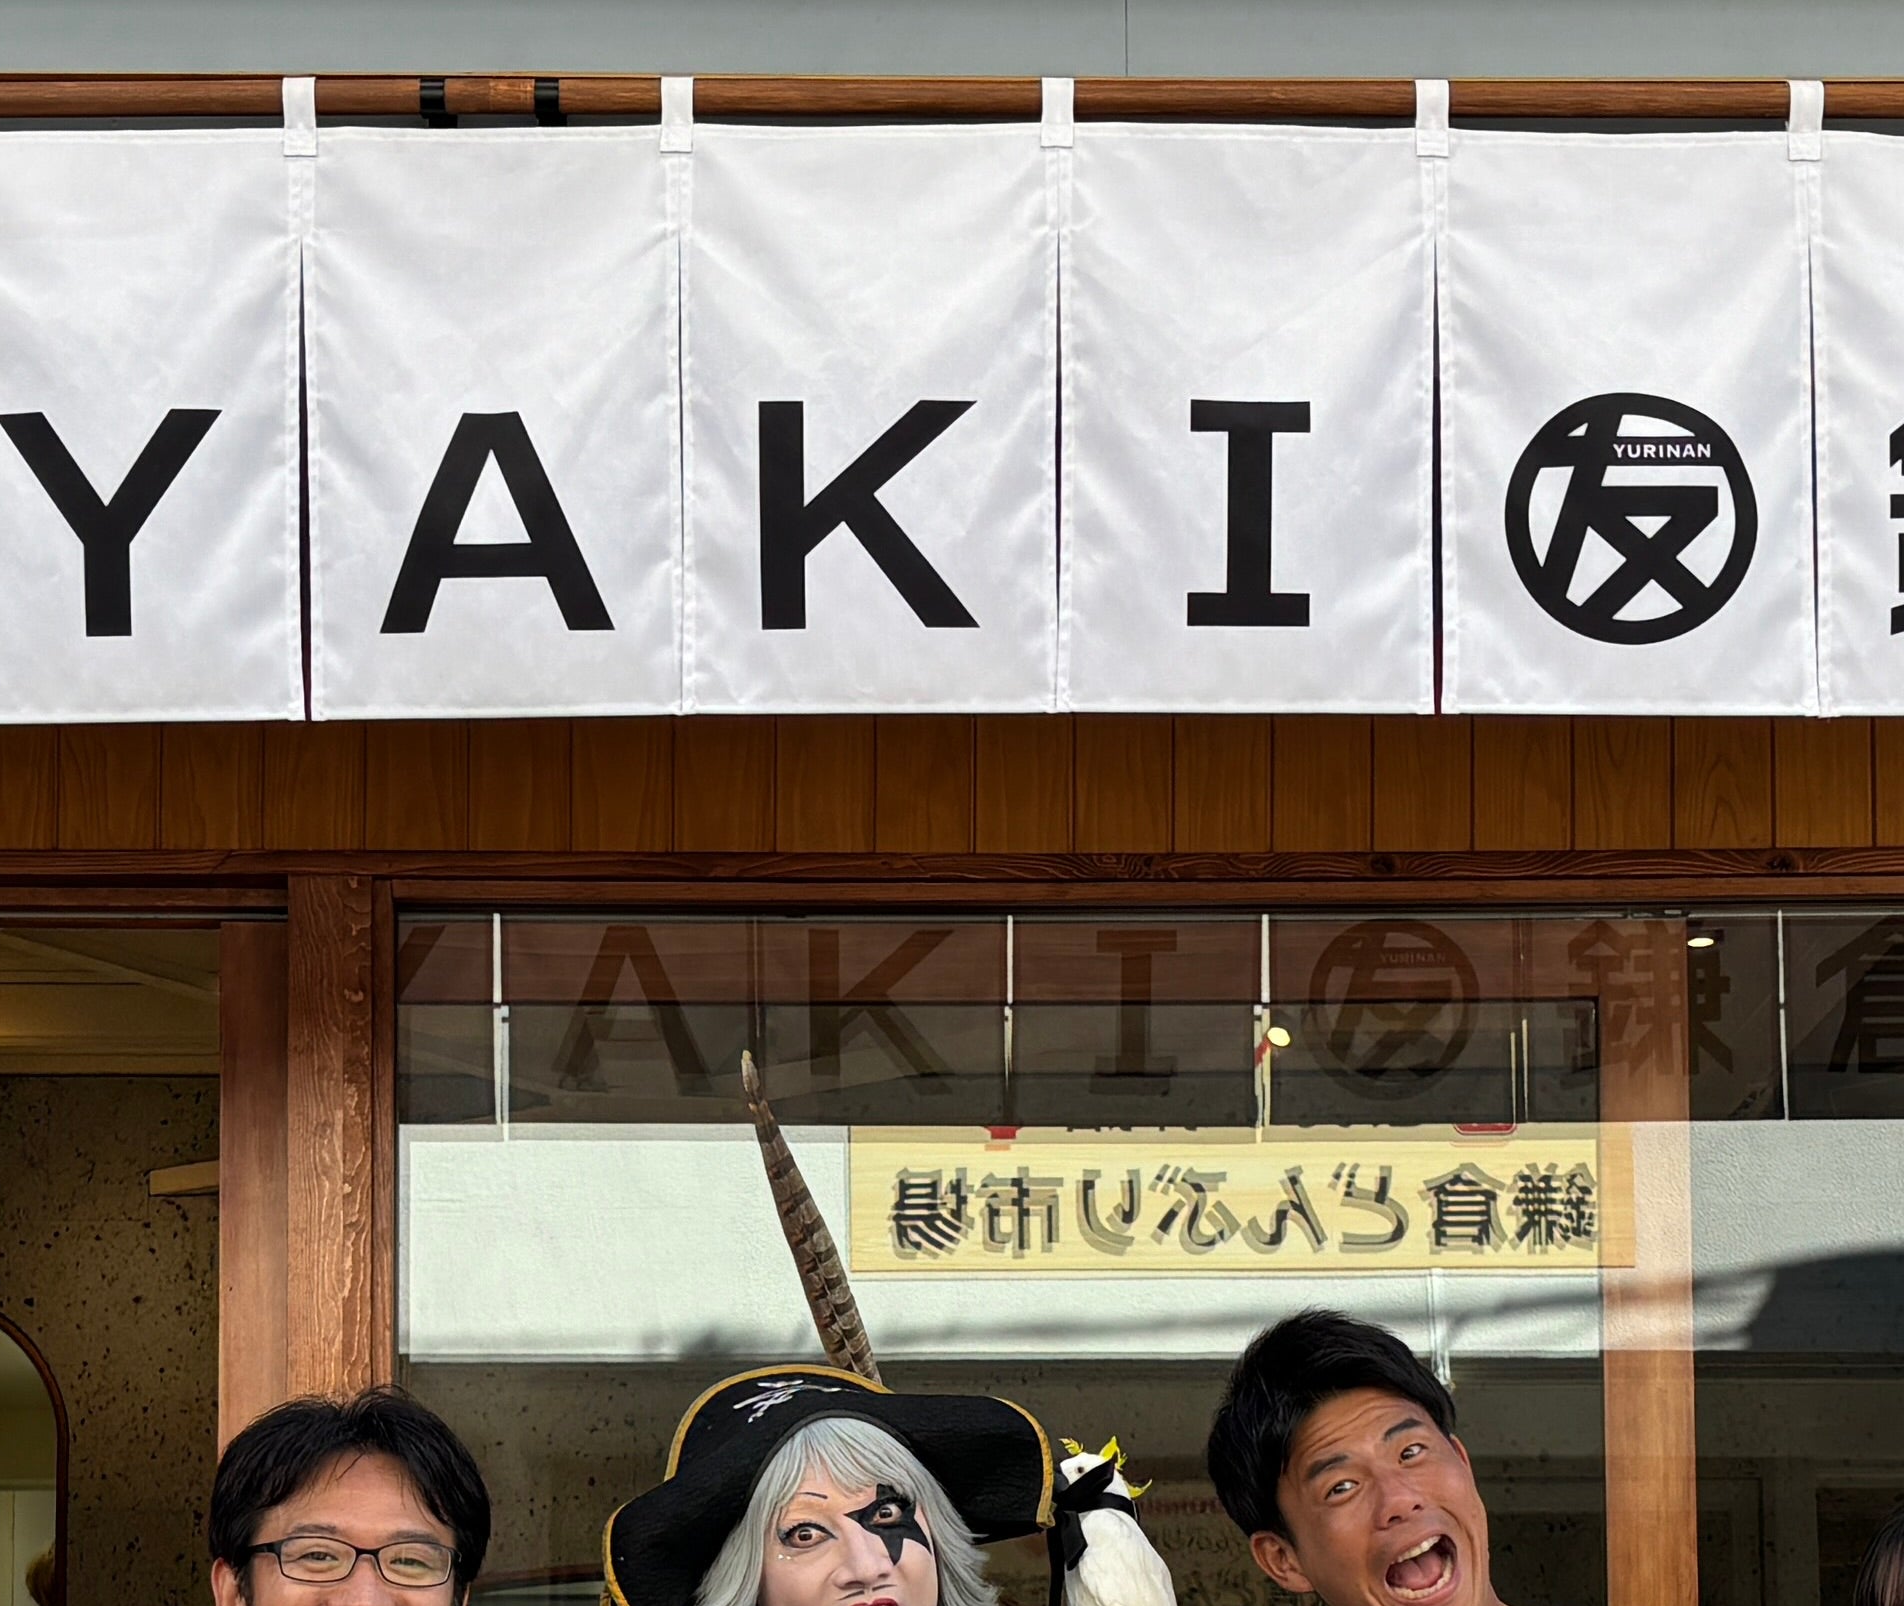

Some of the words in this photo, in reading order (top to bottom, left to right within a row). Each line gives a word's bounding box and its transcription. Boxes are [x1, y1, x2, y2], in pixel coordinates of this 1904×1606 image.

[1505, 392, 1758, 645] 友
[1613, 443, 1711, 459] YURINAN
[397, 922, 1180, 1096] AKI
